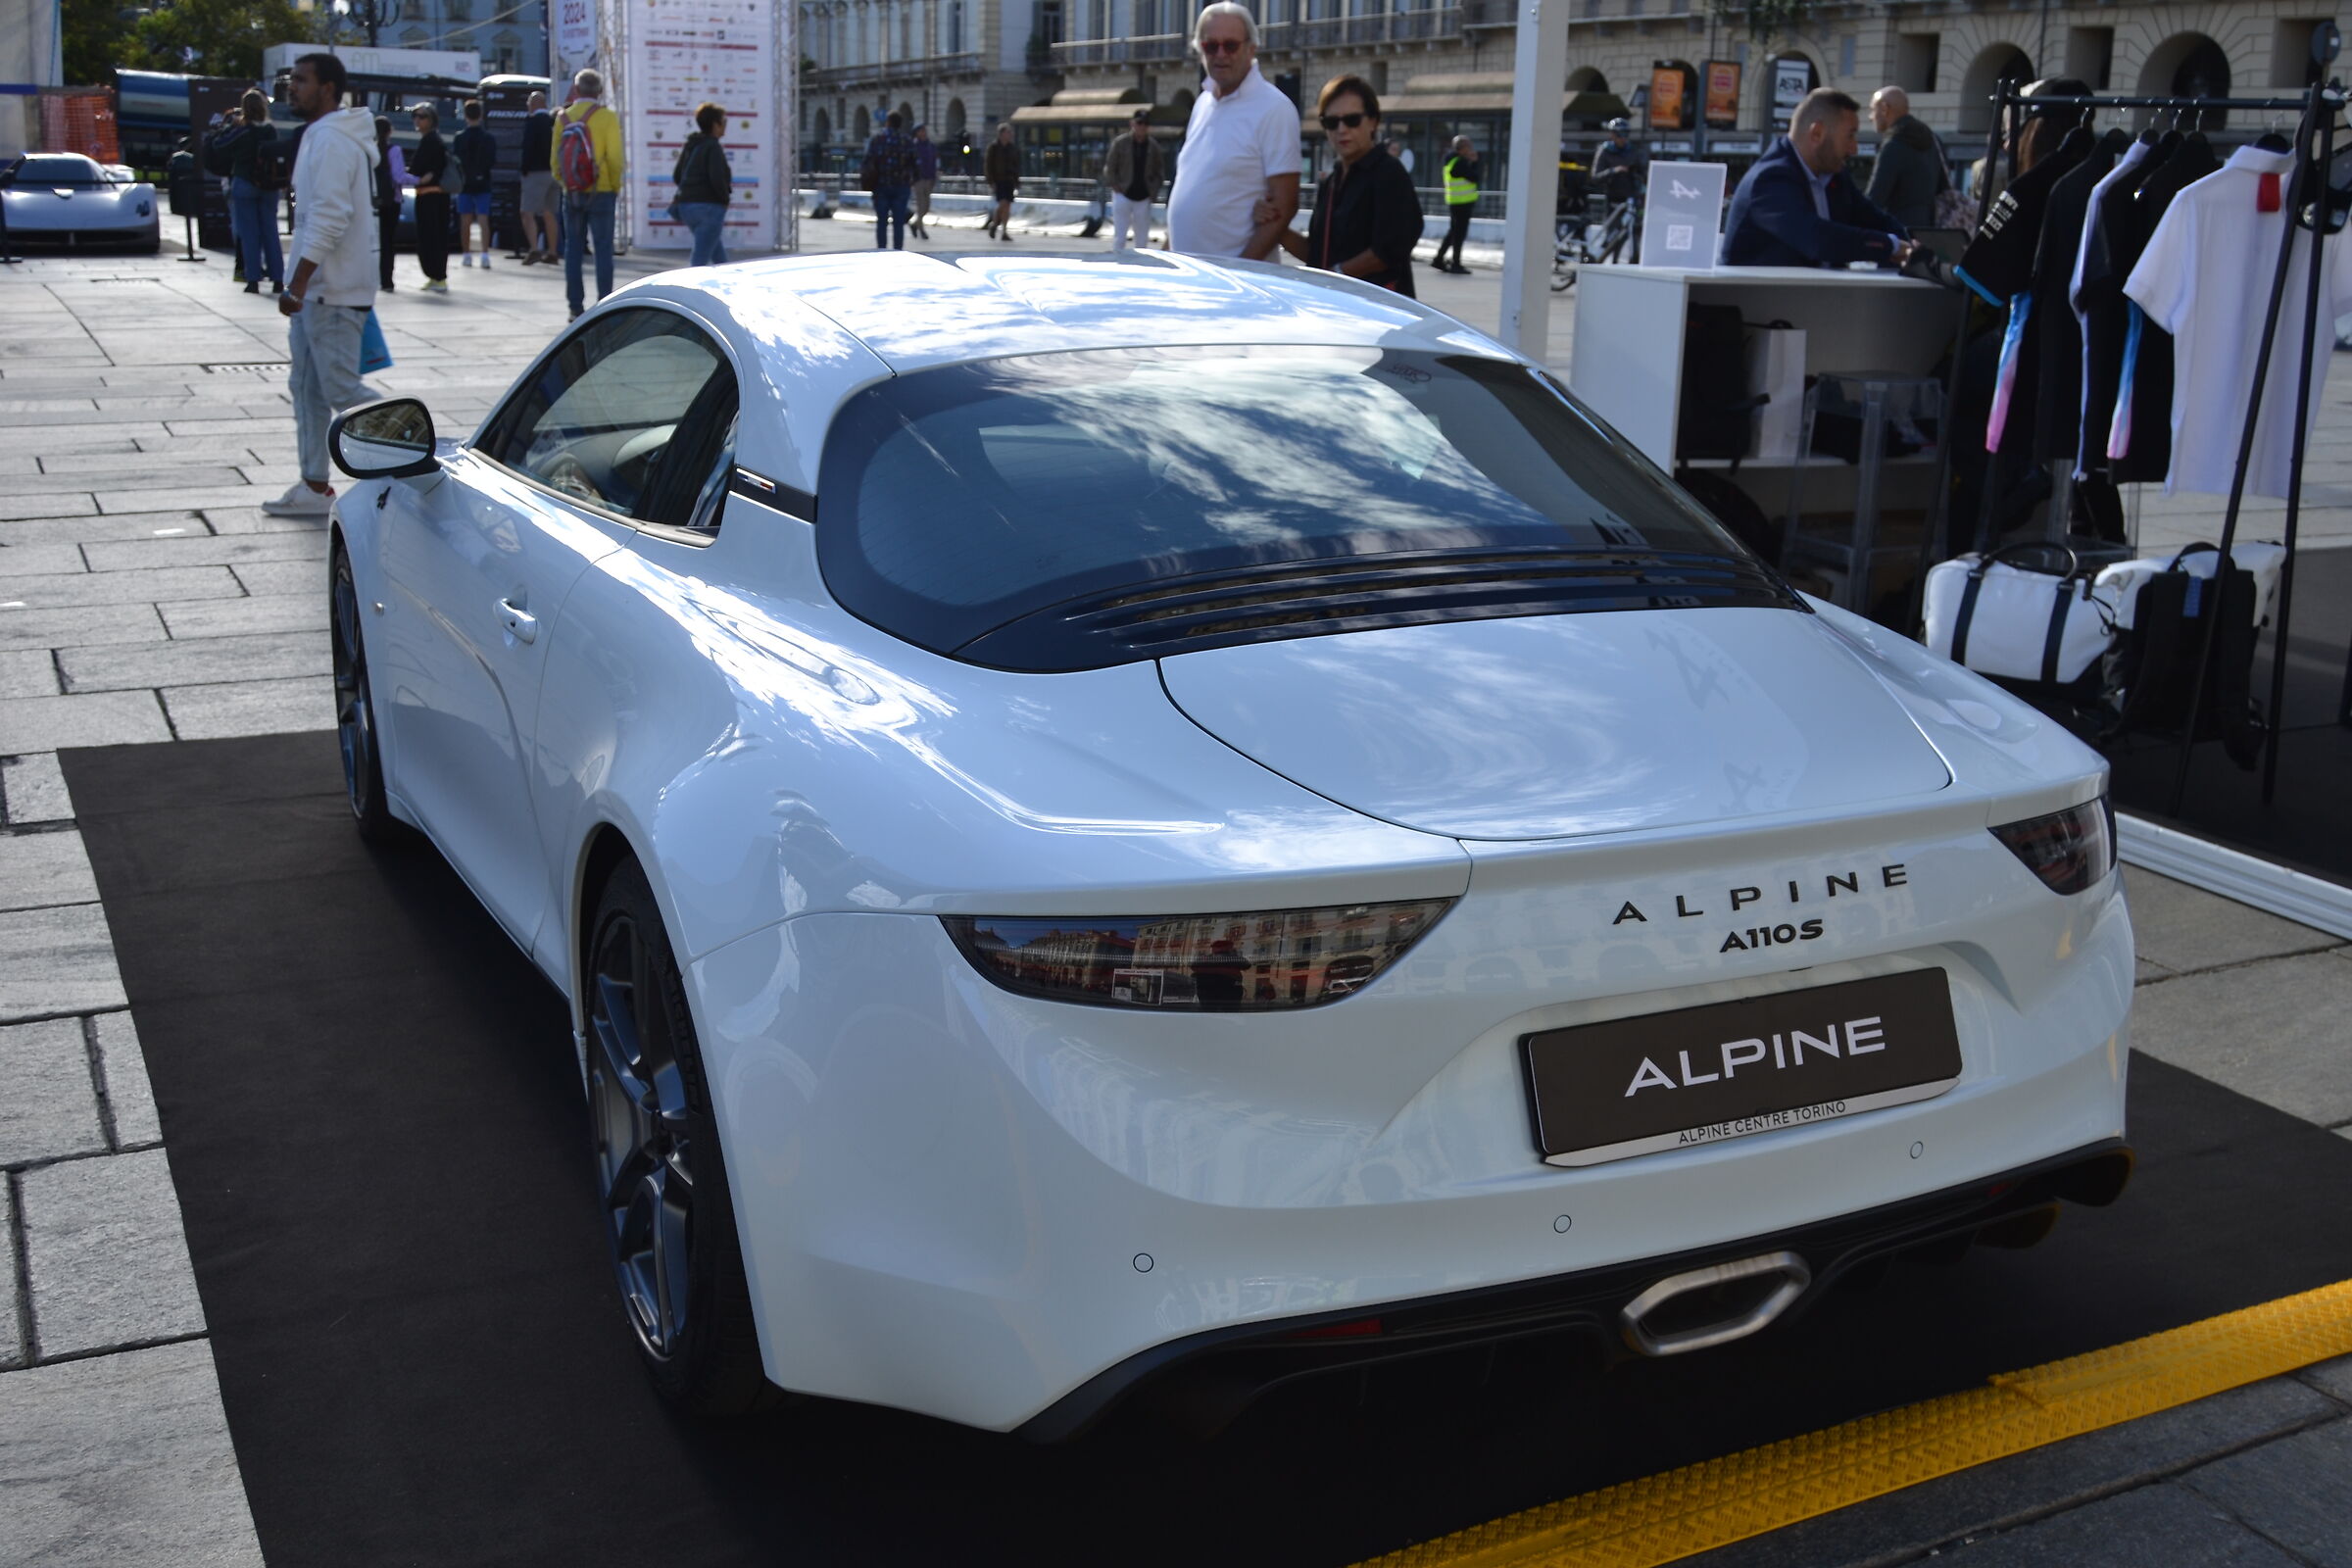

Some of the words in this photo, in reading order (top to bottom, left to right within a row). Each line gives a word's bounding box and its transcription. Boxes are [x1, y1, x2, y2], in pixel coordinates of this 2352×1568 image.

[1612, 863, 1908, 925] ALPINE
[1720, 918, 1824, 953] A110S
[665, 970, 699, 1107] MICHELIN
[1624, 1016, 1886, 1098] ALPINE
[1679, 1122, 1731, 1144] ALPINE
[1736, 1111, 1789, 1133] CENTRE
[1793, 1102, 1845, 1121] TORINO
